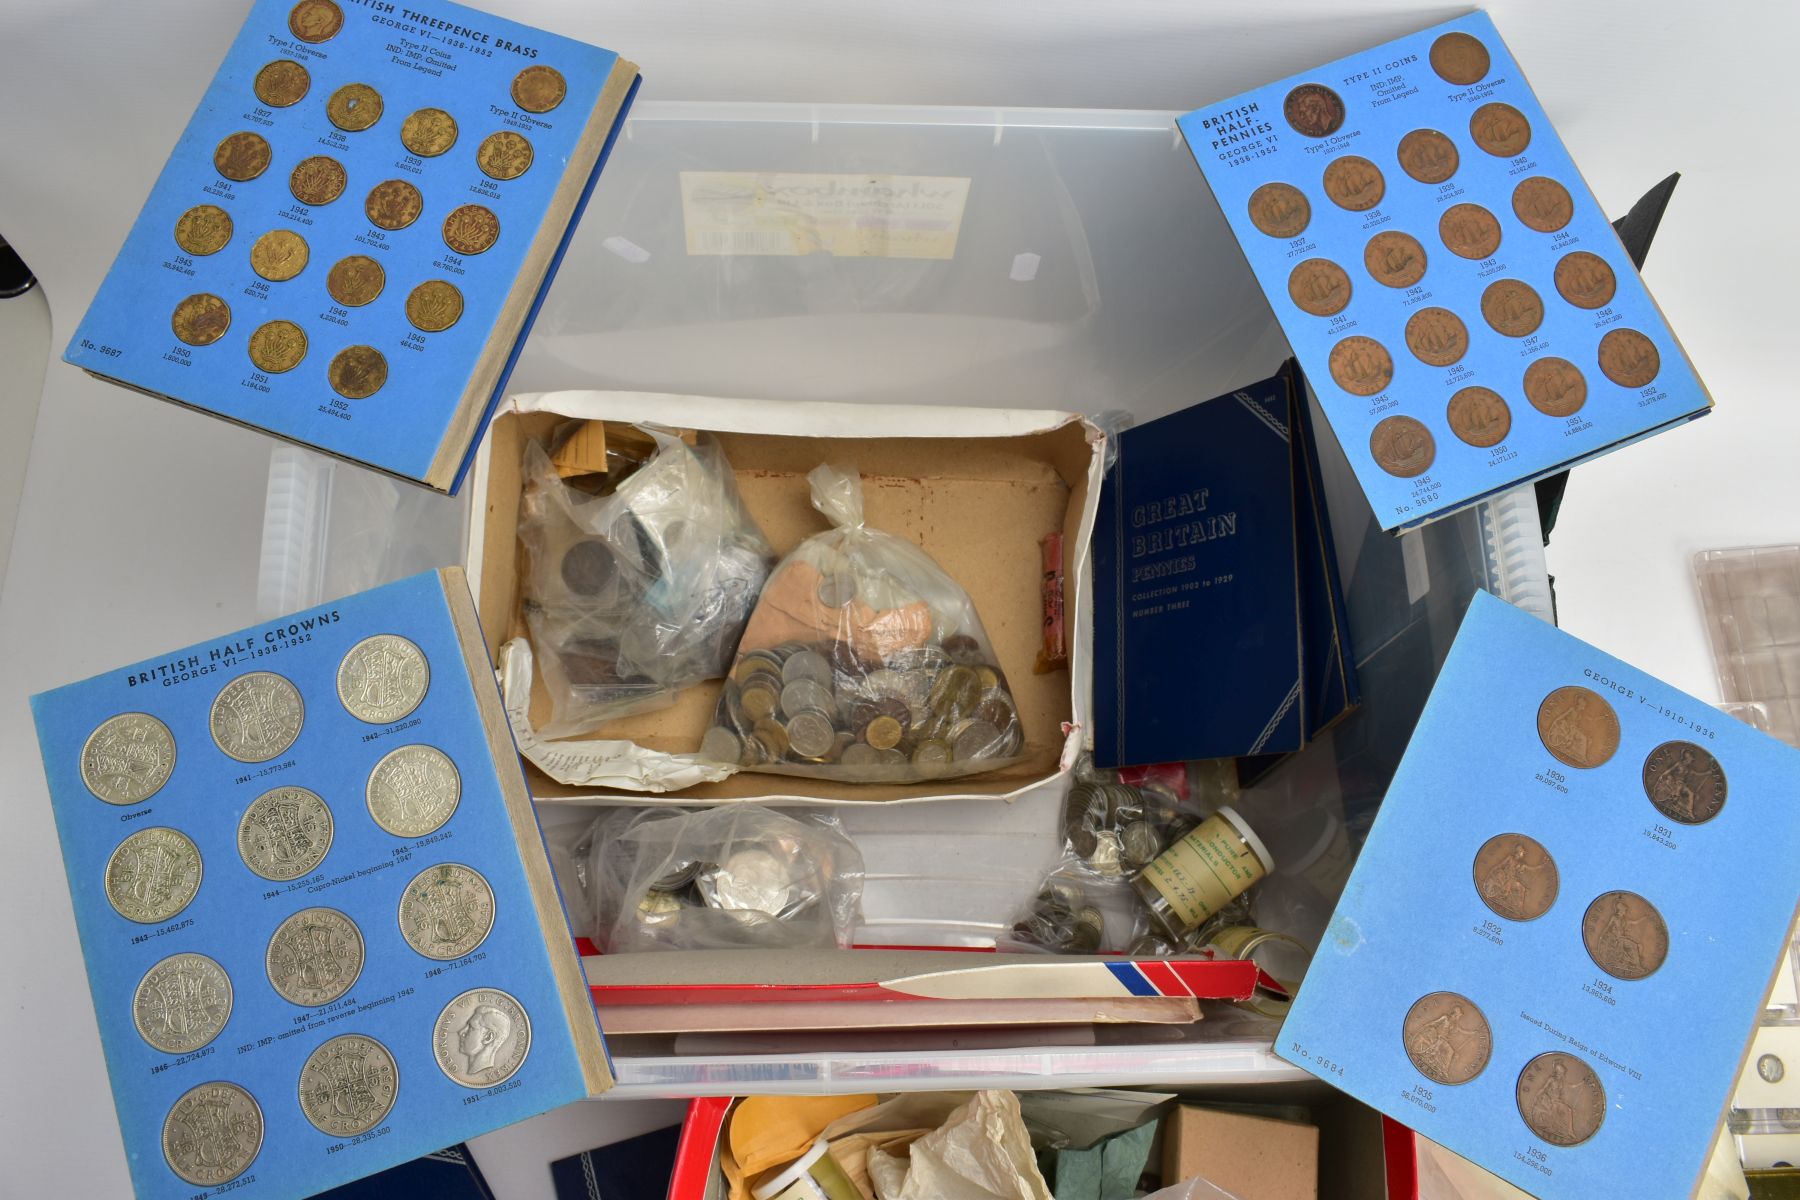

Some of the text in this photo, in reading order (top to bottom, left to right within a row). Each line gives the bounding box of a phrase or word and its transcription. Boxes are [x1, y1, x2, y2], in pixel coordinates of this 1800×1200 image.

[371, 14, 417, 34] GEORGE
[401, 8, 490, 44] THREEPENCE
[494, 38, 538, 59] BRASS
[267, 34, 288, 47] Type
[294, 43, 328, 60] Obverse
[399, 37, 452, 60] Type II Coins
[390, 54, 443, 77] From Legend
[424, 56, 457, 72] Omitted
[1342, 54, 1418, 86] TYPE II COINS
[1370, 85, 1419, 108] From Legend
[1376, 81, 1406, 97] Omitted
[1447, 78, 1506, 102] Type II Obverse
[252, 106, 272, 118] 1937
[489, 104, 553, 130] Type II Obverse
[1201, 101, 1259, 130] BRITISH
[327, 131, 347, 142] 1938
[1211, 121, 1273, 150] PENNIES
[1303, 143, 1324, 154] Type
[1329, 130, 1361, 145] Obverse
[1218, 134, 1278, 161] GEORGE VI
[403, 155, 423, 167] 1939
[1227, 144, 1278, 168] 1936-1952
[1510, 156, 1528, 167] 1940
[213, 179, 232, 191] 1941
[479, 178, 498, 191] 1940
[1437, 182, 1455, 194] 1939
[289, 204, 309, 216] 1942
[1363, 209, 1382, 221] 1938
[366, 228, 386, 241] 1943
[1552, 230, 1570, 242] 1944
[1288, 236, 1306, 249] 1937
[173, 255, 193, 267] 1945
[443, 254, 463, 266] 1944
[1479, 257, 1497, 270] 1943
[250, 280, 270, 292] 1946
[1405, 285, 1423, 298] 1942
[328, 305, 348, 318] 1948
[1595, 307, 1613, 319] 1948
[1329, 314, 1347, 326] 1941
[406, 331, 426, 344] 1949
[1521, 335, 1538, 347] 1947
[79, 338, 122, 358] No. 9687
[171, 345, 191, 358] 1950
[249, 371, 269, 384] 1951
[1447, 364, 1465, 376] 1946
[1370, 393, 1389, 406] 1945
[1639, 386, 1657, 398] 1952
[328, 398, 349, 411] 1952
[1565, 415, 1583, 428] 1951
[1489, 444, 1508, 458] 1950
[1412, 475, 1431, 488] 1949
[1132, 488, 1209, 528] GREAT
[1394, 492, 1439, 515] No. 9680
[1132, 512, 1236, 558] BRITAIN
[1132, 555, 1196, 582] PENNIES
[1132, 586, 1178, 601] COLLECTION
[127, 610, 340, 687] BRITISH HALF CROWNS
[162, 663, 217, 687] GEORGE
[1583, 668, 1634, 698] GEORGE
[1545, 768, 1565, 783] 1930
[119, 808, 153, 822] Obverse
[1653, 823, 1672, 839] 1931
[356, 860, 394, 877] beginning
[395, 852, 412, 864] 1947
[1481, 919, 1502, 936] 1932
[1592, 977, 1613, 995] 1934
[277, 1024, 306, 1040] omitted
[307, 1019, 326, 1030] from
[326, 1008, 356, 1023] reverse
[356, 994, 396, 1013] beginning
[396, 986, 414, 999] 1949
[1519, 1010, 1642, 1081] Issued During Reign of Edward VIII
[1291, 1042, 1344, 1077] No. 9684
[1412, 1084, 1433, 1101] 1935
[1526, 1145, 1547, 1162] 1936
